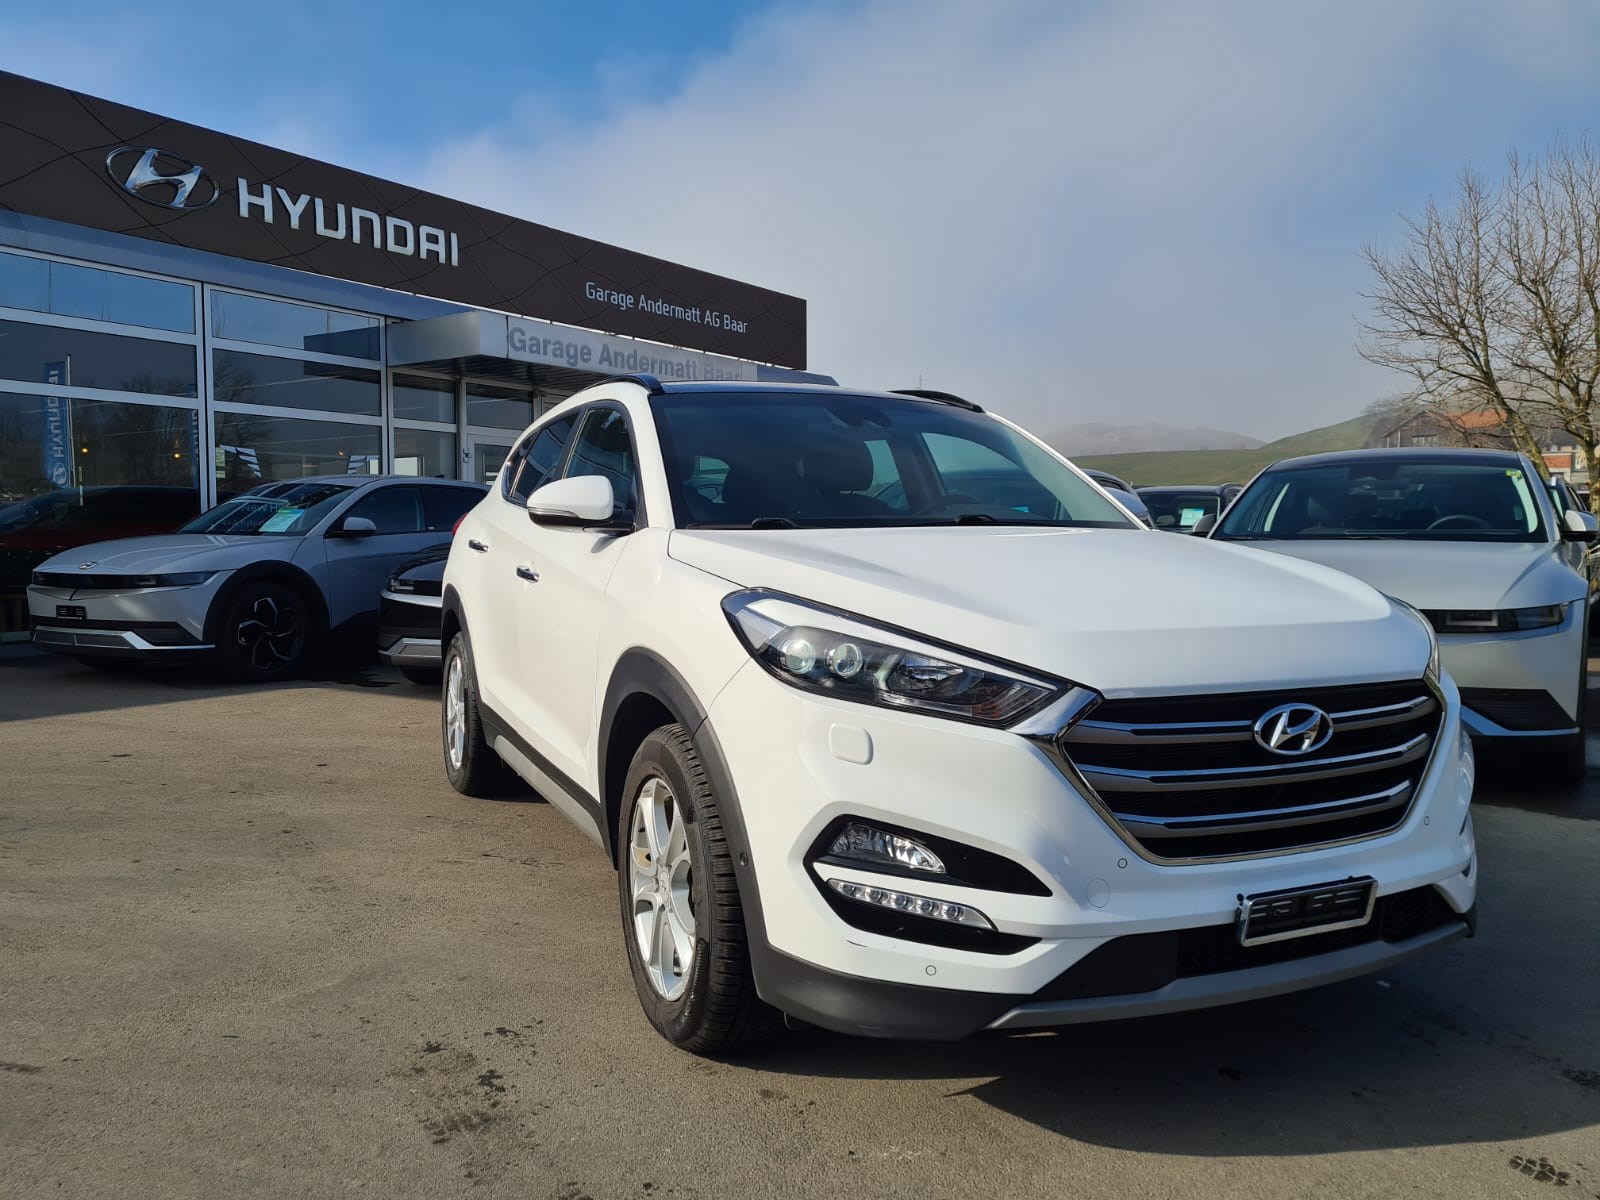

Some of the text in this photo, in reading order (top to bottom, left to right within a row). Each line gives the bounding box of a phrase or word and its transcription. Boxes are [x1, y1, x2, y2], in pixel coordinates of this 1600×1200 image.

[237, 176, 459, 267] HYUNDAI
[585, 281, 749, 334] Garage Andermatt AG Baar
[508, 326, 741, 382] Garage Andermatt Baar
